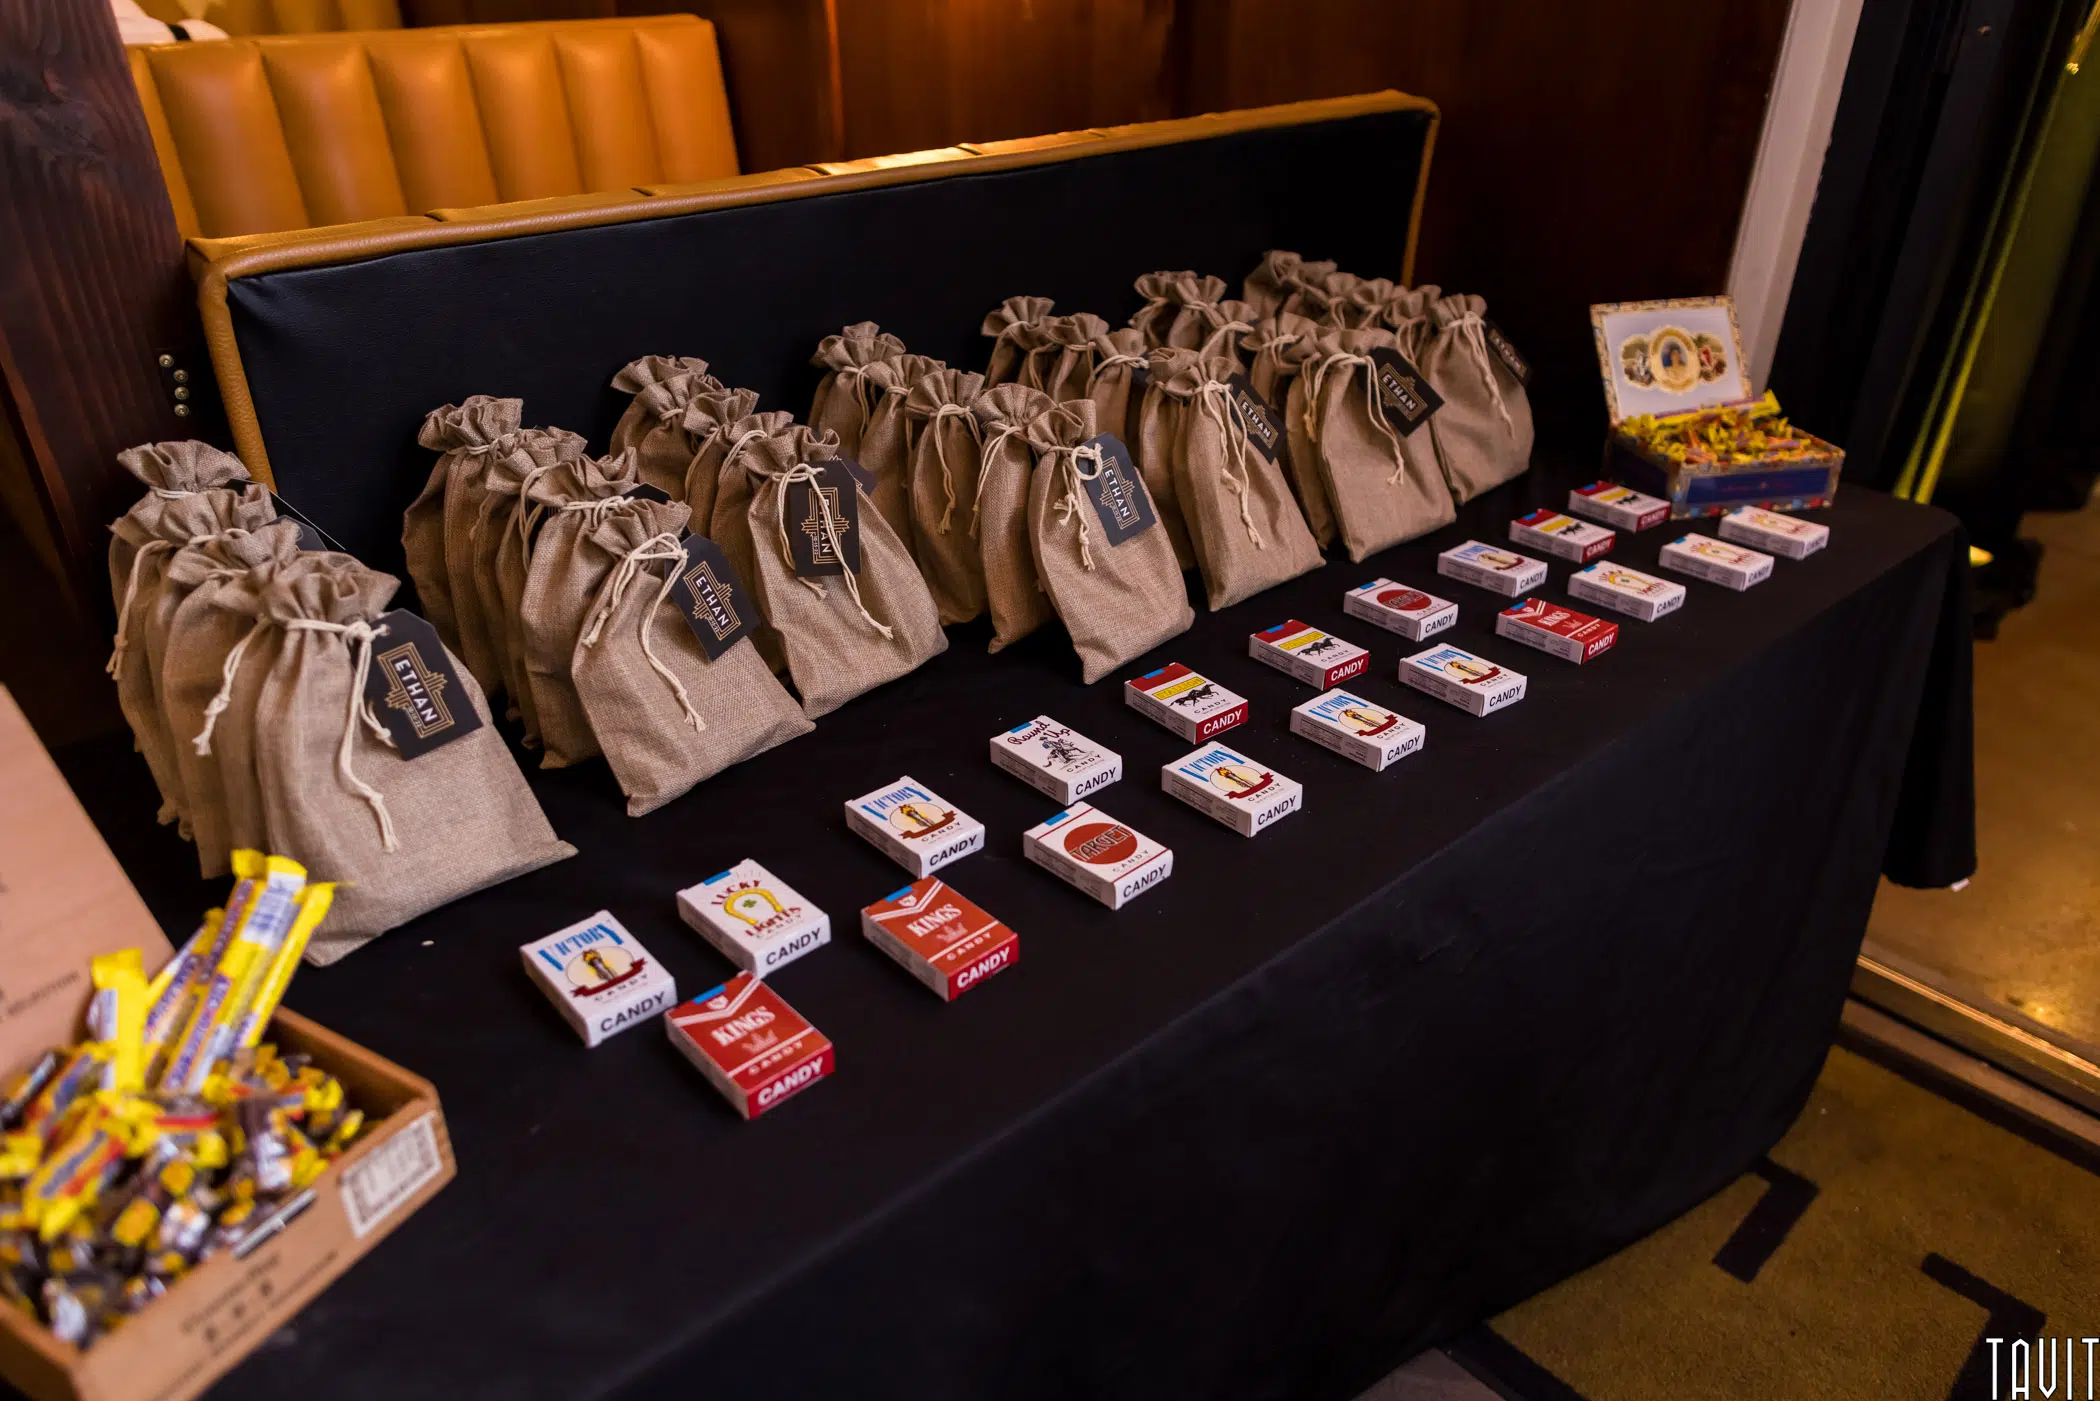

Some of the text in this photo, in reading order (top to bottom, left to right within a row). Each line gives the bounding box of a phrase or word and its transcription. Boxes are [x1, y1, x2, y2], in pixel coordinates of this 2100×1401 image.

[1382, 374, 1417, 410] ETHAN
[1241, 402, 1271, 438] ETHAN
[1104, 469, 1130, 517] ETHAN
[1520, 570, 1545, 590] CANDY
[695, 576, 729, 626] ETHAN
[1656, 595, 1683, 613] CANDY
[1425, 613, 1455, 633] CANDY
[1588, 632, 1615, 655] CANDY
[1330, 659, 1364, 681] CANDY
[394, 659, 438, 722] ETHAN
[1489, 685, 1522, 707] CANDY
[1194, 698, 1227, 715] CANDY
[1203, 708, 1243, 735] CANDY
[1308, 692, 1369, 723] VICTORY
[1007, 720, 1050, 745] Round
[1043, 728, 1070, 740] Up
[1377, 722, 1407, 739] CANDY
[1066, 754, 1101, 773] CANDY
[1387, 735, 1421, 761] CANDY
[1178, 746, 1246, 783] VICTORY
[1075, 767, 1117, 796] CANDY
[1247, 782, 1281, 802] CANDY
[861, 783, 932, 821] VICTORY
[1257, 795, 1297, 826] CANDY
[921, 822, 961, 842] CANDY
[1069, 825, 1133, 861] TARGET
[929, 834, 978, 867] CANDY
[1112, 849, 1149, 873] CANDY
[1122, 864, 1167, 899] CANDY
[905, 903, 962, 937] KINGS
[765, 928, 821, 966] CANDY
[957, 946, 1010, 988] CANDY
[600, 991, 665, 1032] CANDY
[711, 1005, 776, 1047] KINGS
[757, 1056, 823, 1106] CANDY
